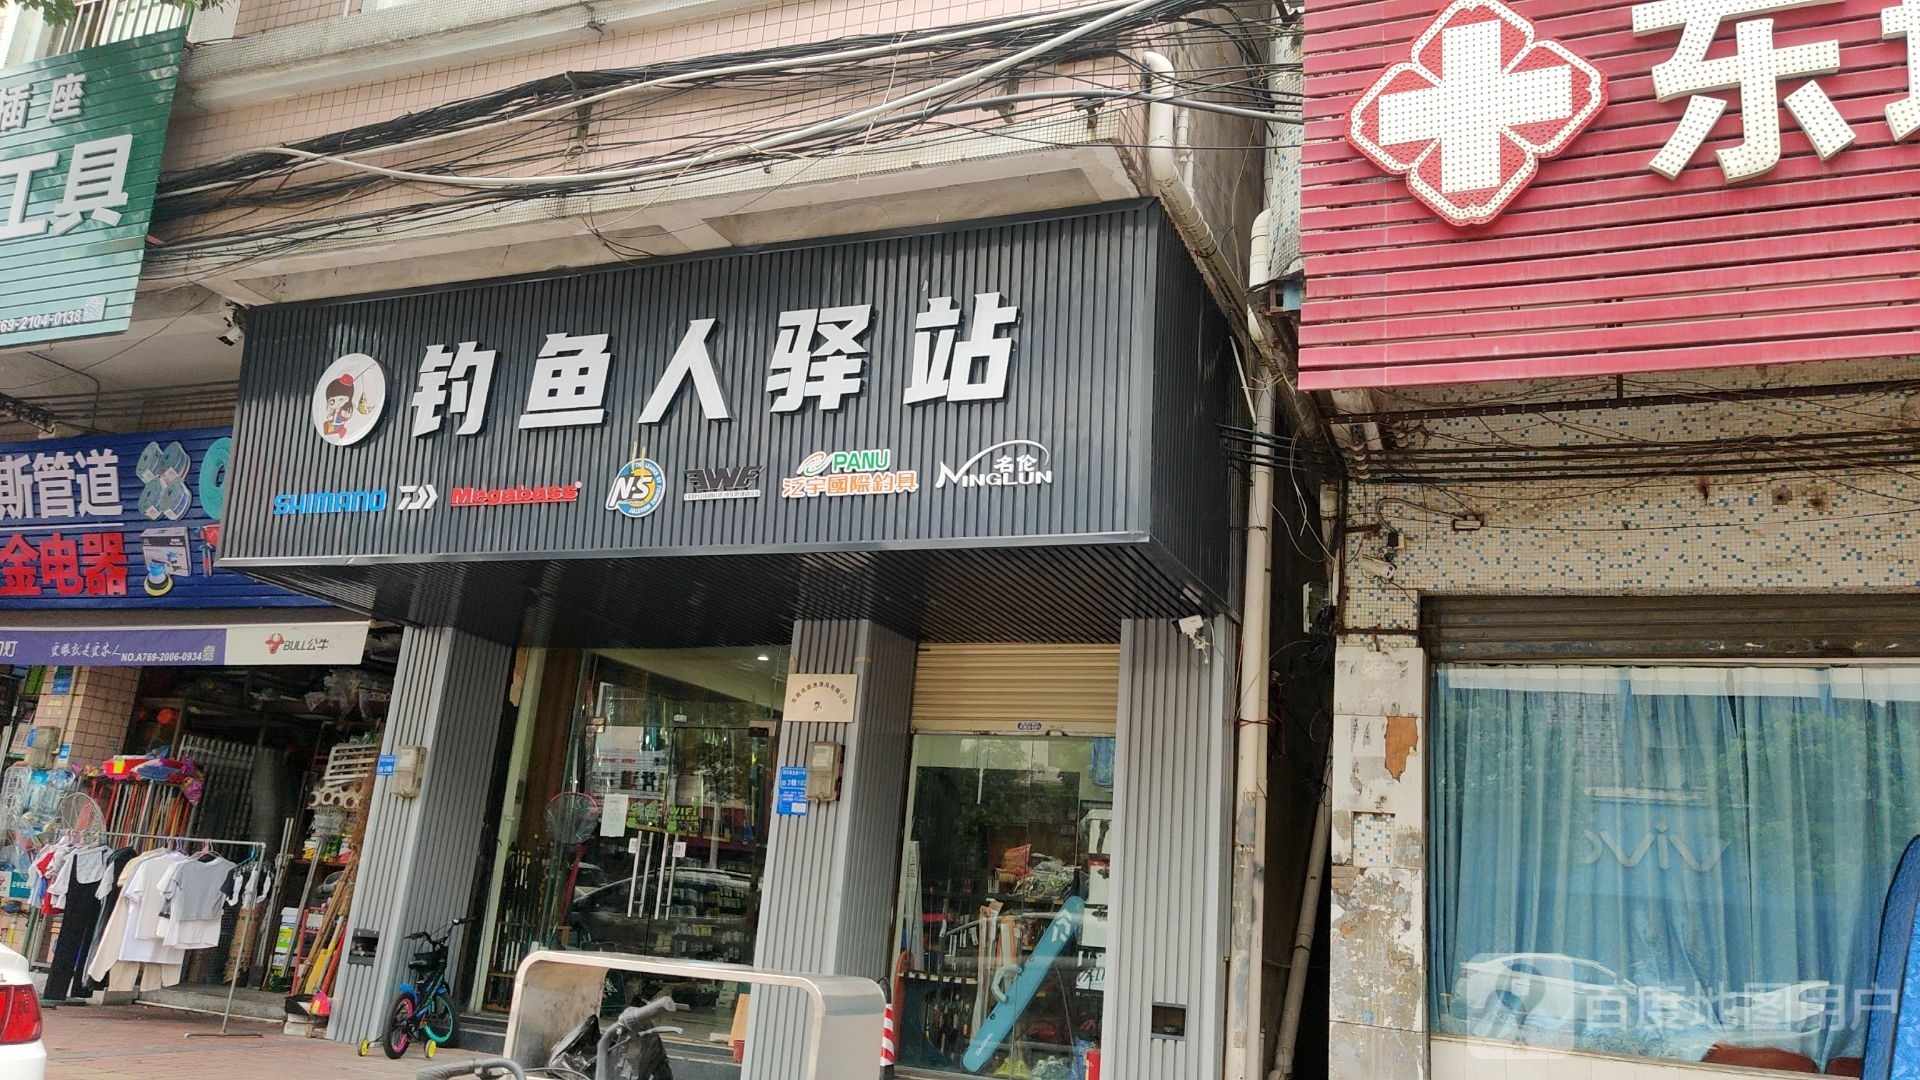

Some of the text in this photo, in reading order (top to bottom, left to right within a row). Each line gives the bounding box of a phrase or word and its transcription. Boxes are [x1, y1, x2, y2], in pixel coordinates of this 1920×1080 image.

[1632, 0, 1920, 183] 东
[0, 134, 133, 240] 工具
[412, 291, 1019, 438] 钓鱼人驿站
[273, 489, 387, 515] SHIMANO
[994, 455, 1038, 473] 名伦
[0, 532, 128, 596] 金电器
